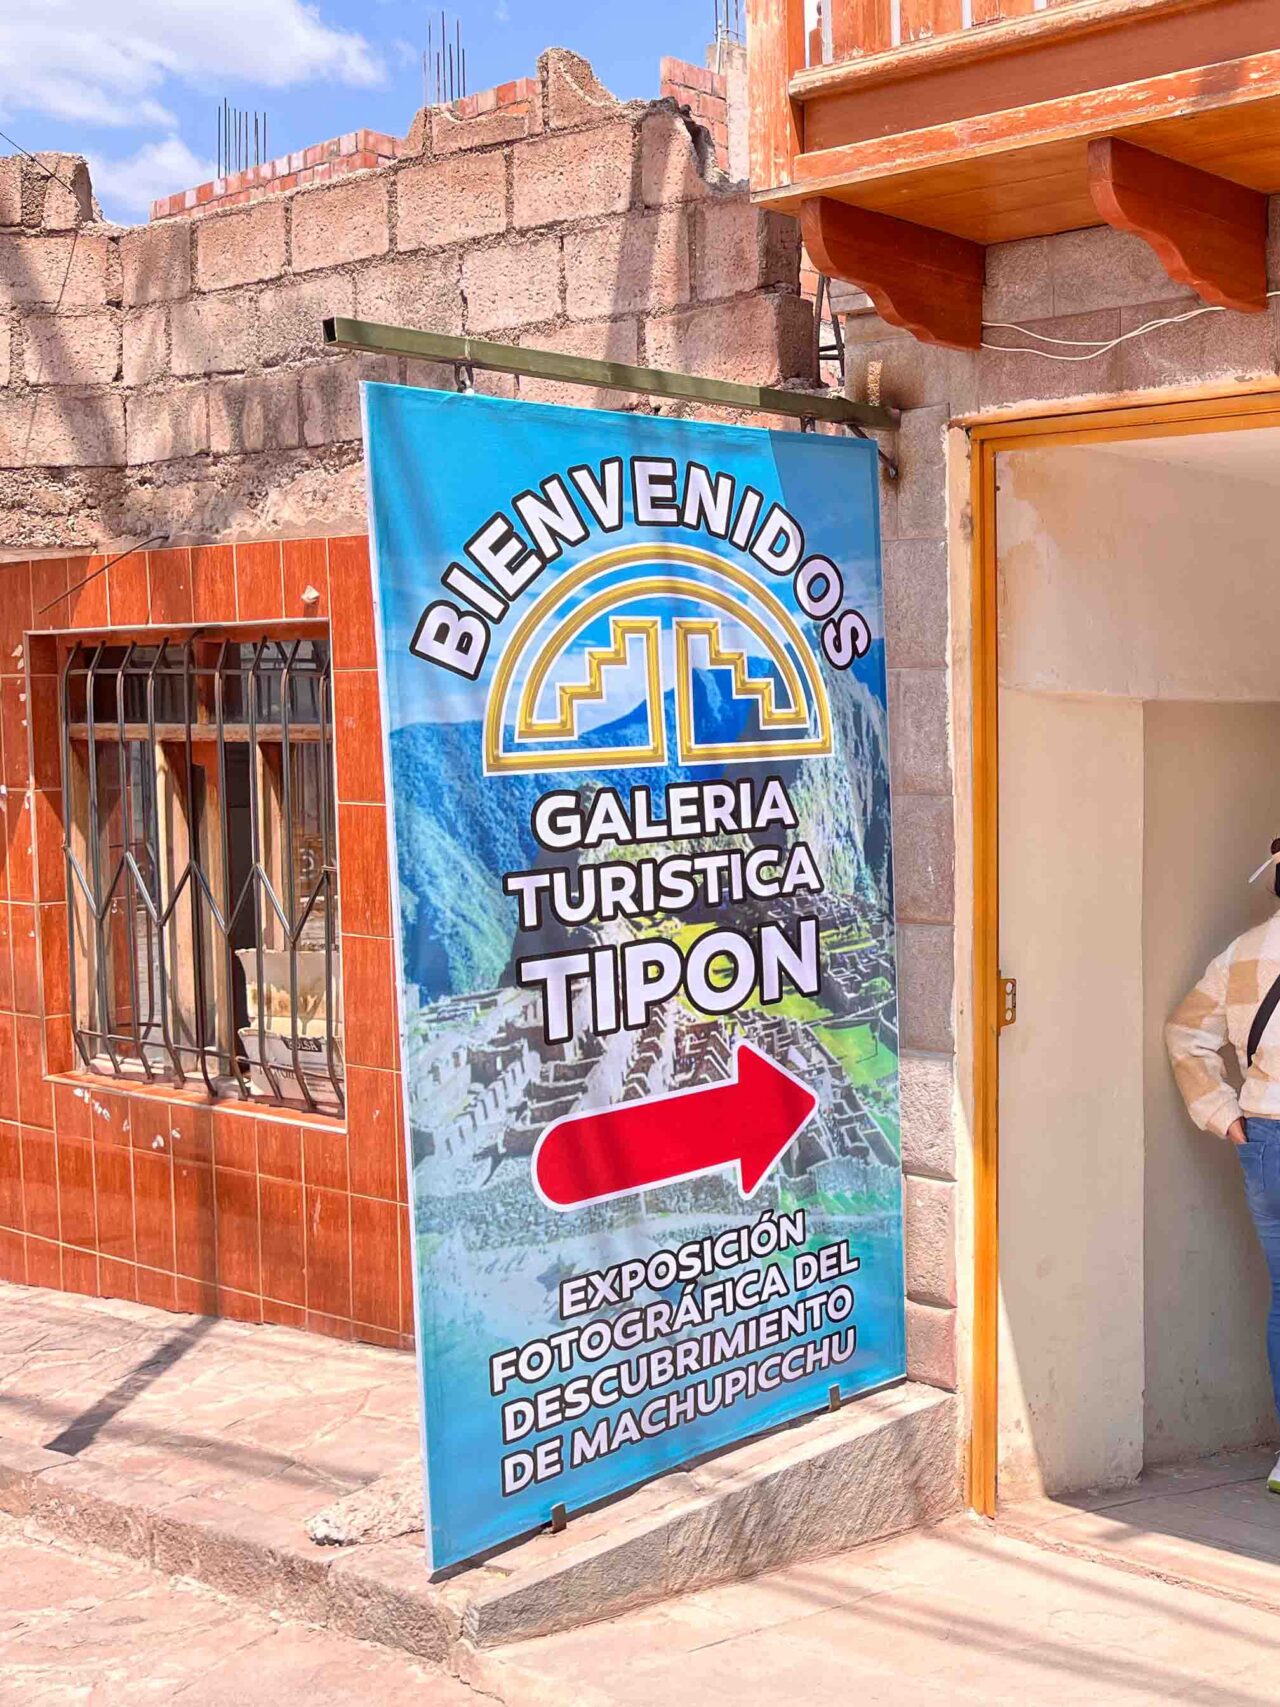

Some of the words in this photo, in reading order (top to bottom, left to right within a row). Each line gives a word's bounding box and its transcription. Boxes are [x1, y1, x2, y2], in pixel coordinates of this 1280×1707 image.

[410, 456, 871, 681] BIENVENIDOS
[533, 777, 798, 851] GALERIA
[504, 842, 823, 931] TURISTICA
[518, 915, 821, 1044] TIPON
[490, 1264, 789, 1395] FOTOGRÁFICA
[795, 1239, 860, 1291] DEL
[560, 1210, 806, 1319] EXPOSICIÓN
[502, 1285, 854, 1444] DESCUBRIMIENTO
[502, 1437, 564, 1496] DE
[571, 1327, 857, 1468] MACHUPICCHU
